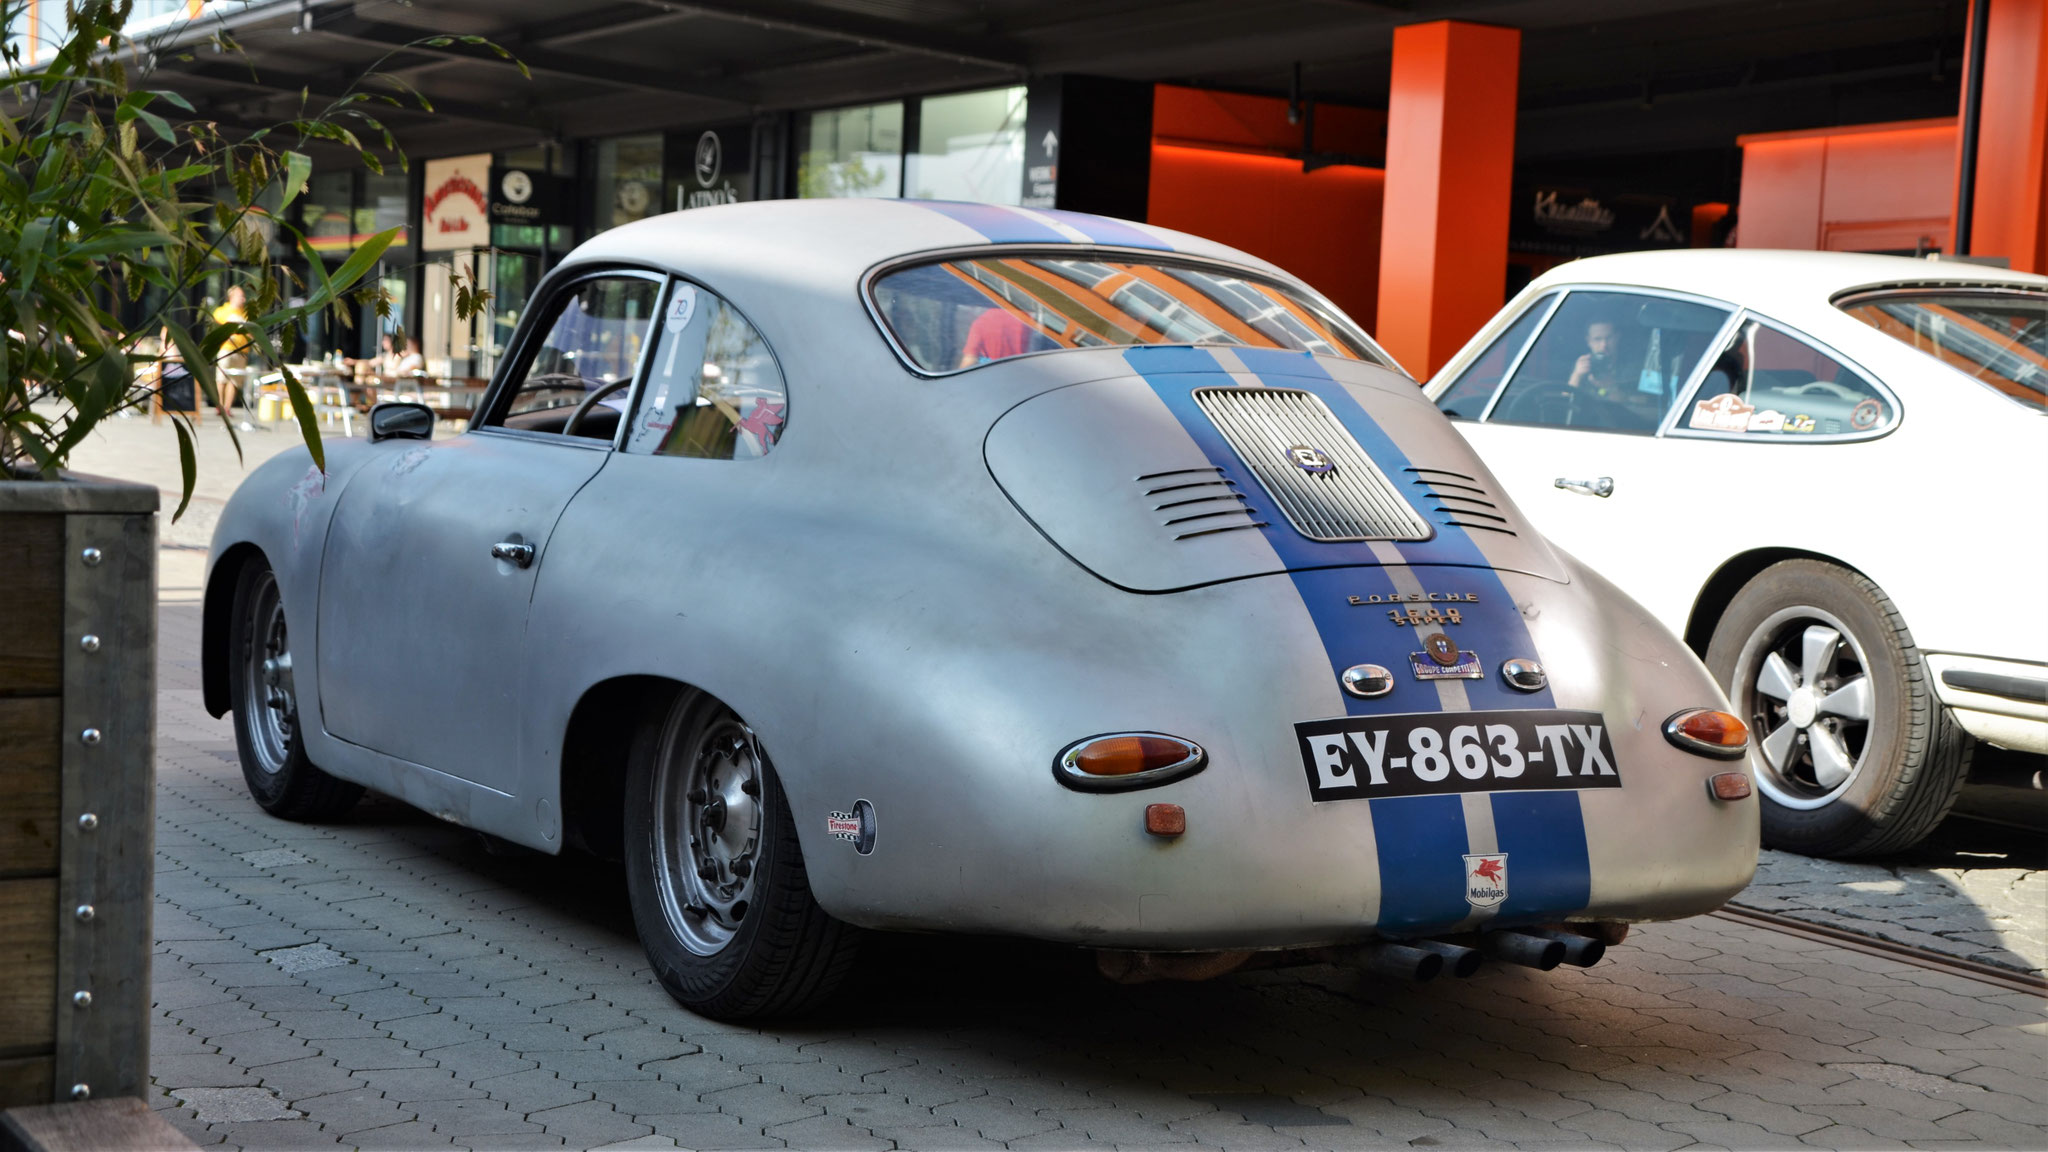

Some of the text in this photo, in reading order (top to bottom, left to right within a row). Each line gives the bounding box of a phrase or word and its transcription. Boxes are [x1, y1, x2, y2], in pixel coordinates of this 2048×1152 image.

[1347, 593, 1479, 605] PORSCHE
[1394, 616, 1462, 625] SUPER
[1306, 724, 1616, 789] EY-863-TX
[829, 820, 857, 830] Firestone
[1470, 887, 1505, 900] Mobilgas
